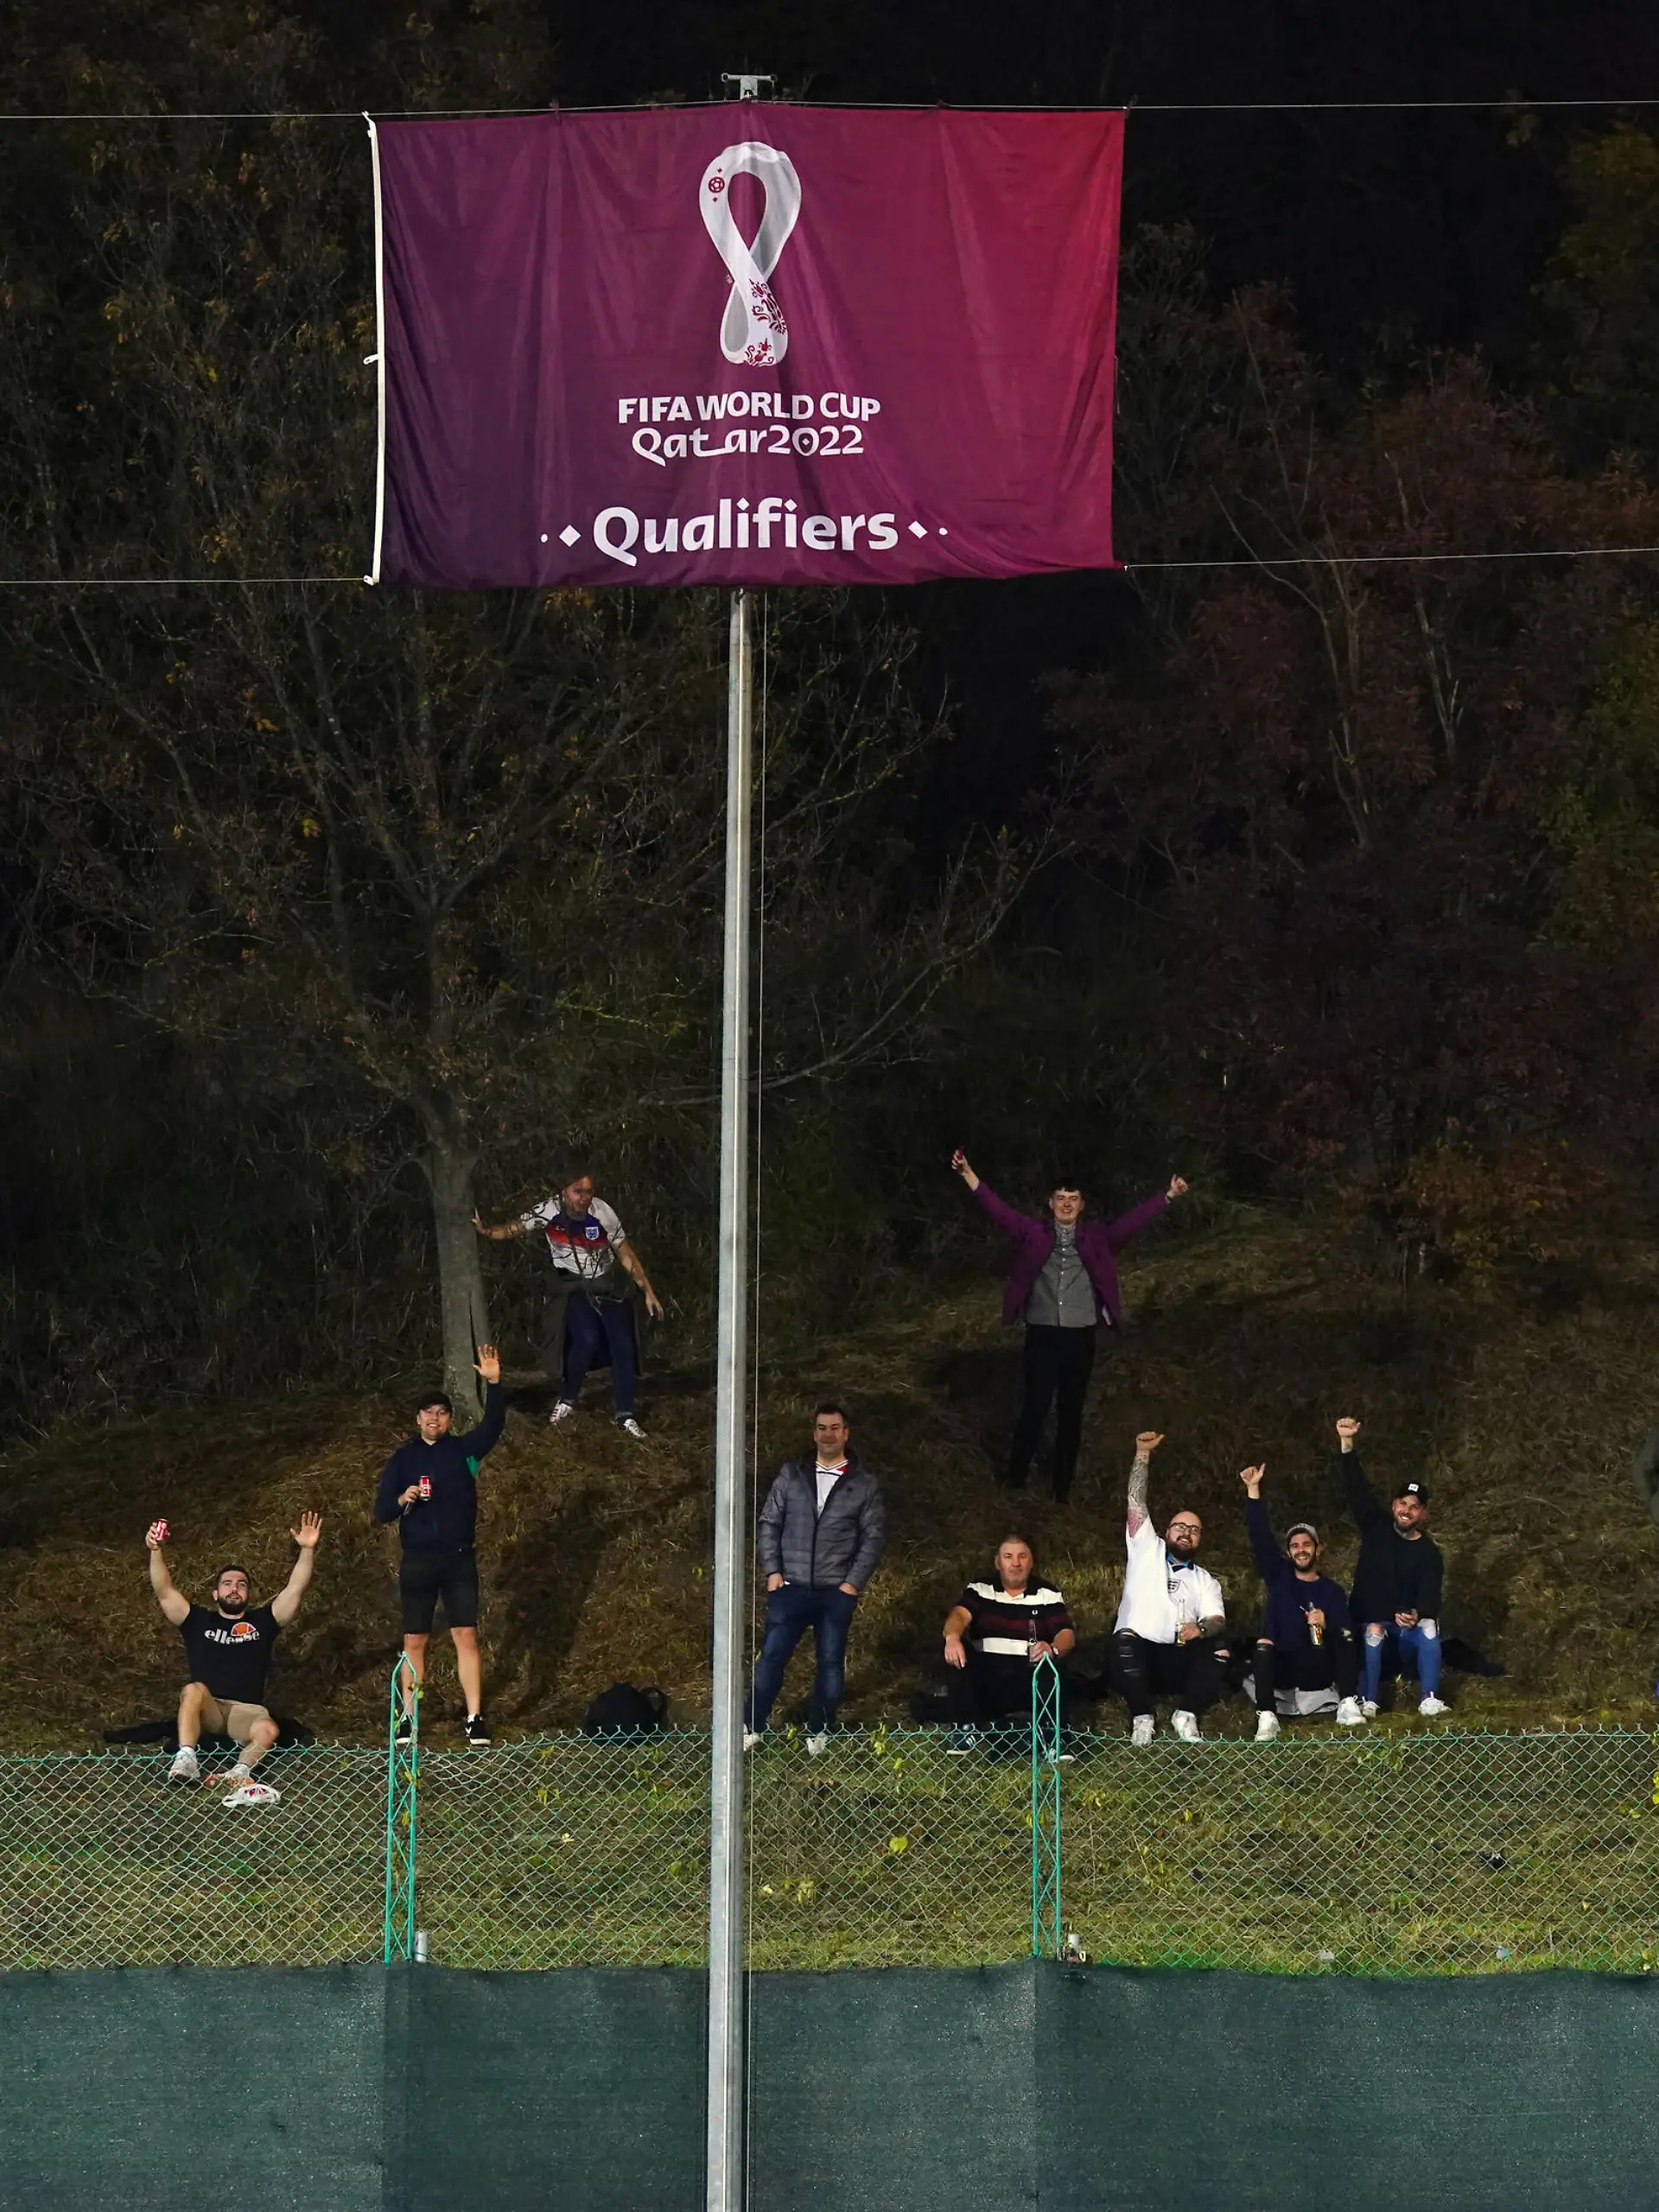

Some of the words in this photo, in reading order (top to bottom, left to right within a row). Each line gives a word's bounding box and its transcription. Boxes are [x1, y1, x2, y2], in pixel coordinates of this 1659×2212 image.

[618, 396, 693, 424] FIFA
[696, 391, 815, 421] WORLD
[819, 391, 881, 422] CUP
[593, 497, 899, 567] Qualifiers
